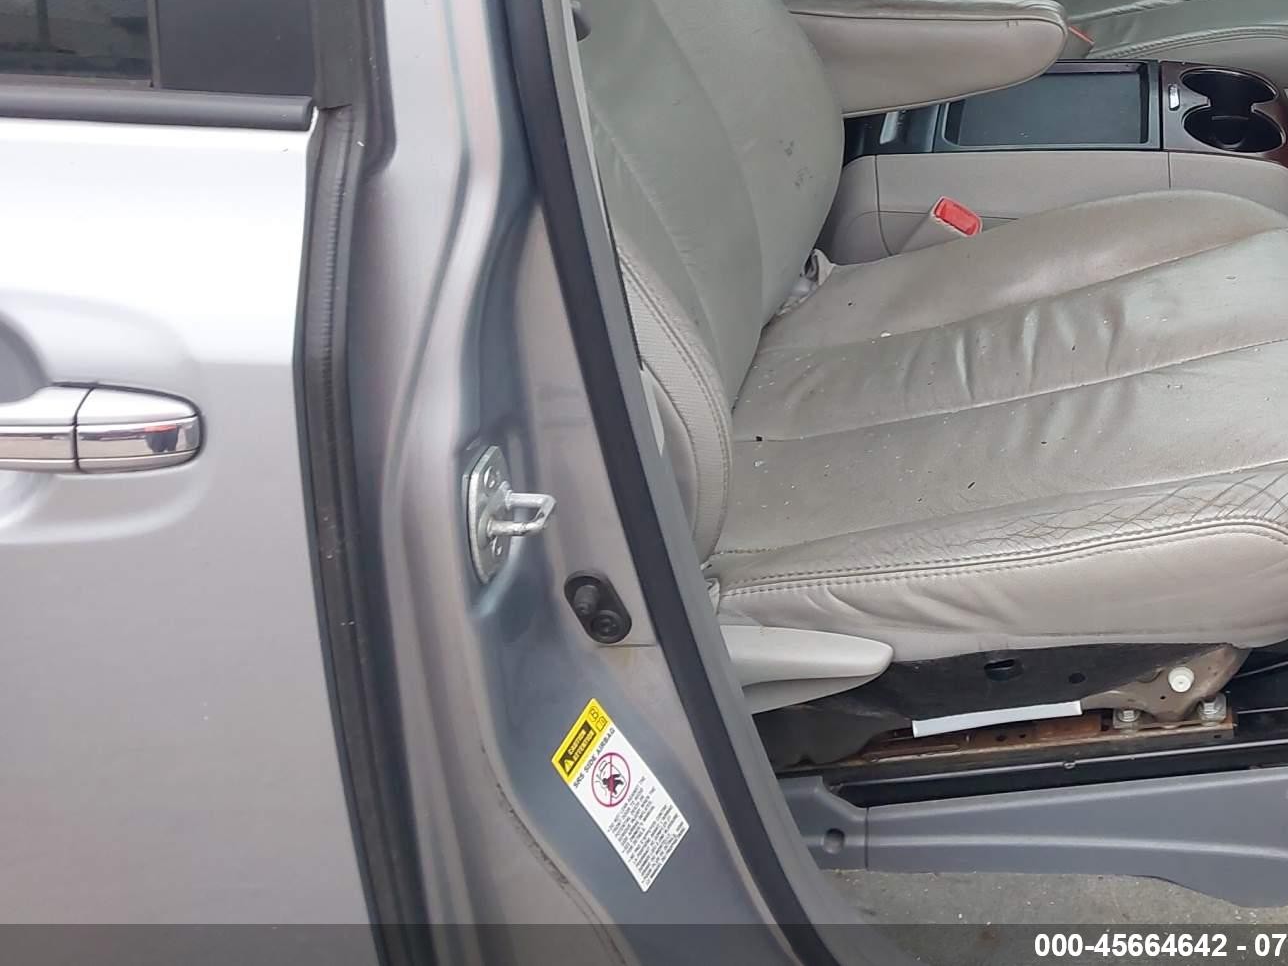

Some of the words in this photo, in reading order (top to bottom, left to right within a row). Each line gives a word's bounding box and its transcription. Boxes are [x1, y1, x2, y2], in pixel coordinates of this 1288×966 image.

[567, 729, 587, 756] CAUTION
[572, 729, 595, 762] ATTENTION
[573, 774, 585, 789] SRS
[583, 755, 597, 773] SIDE
[596, 727, 616, 756] AIRBAG
